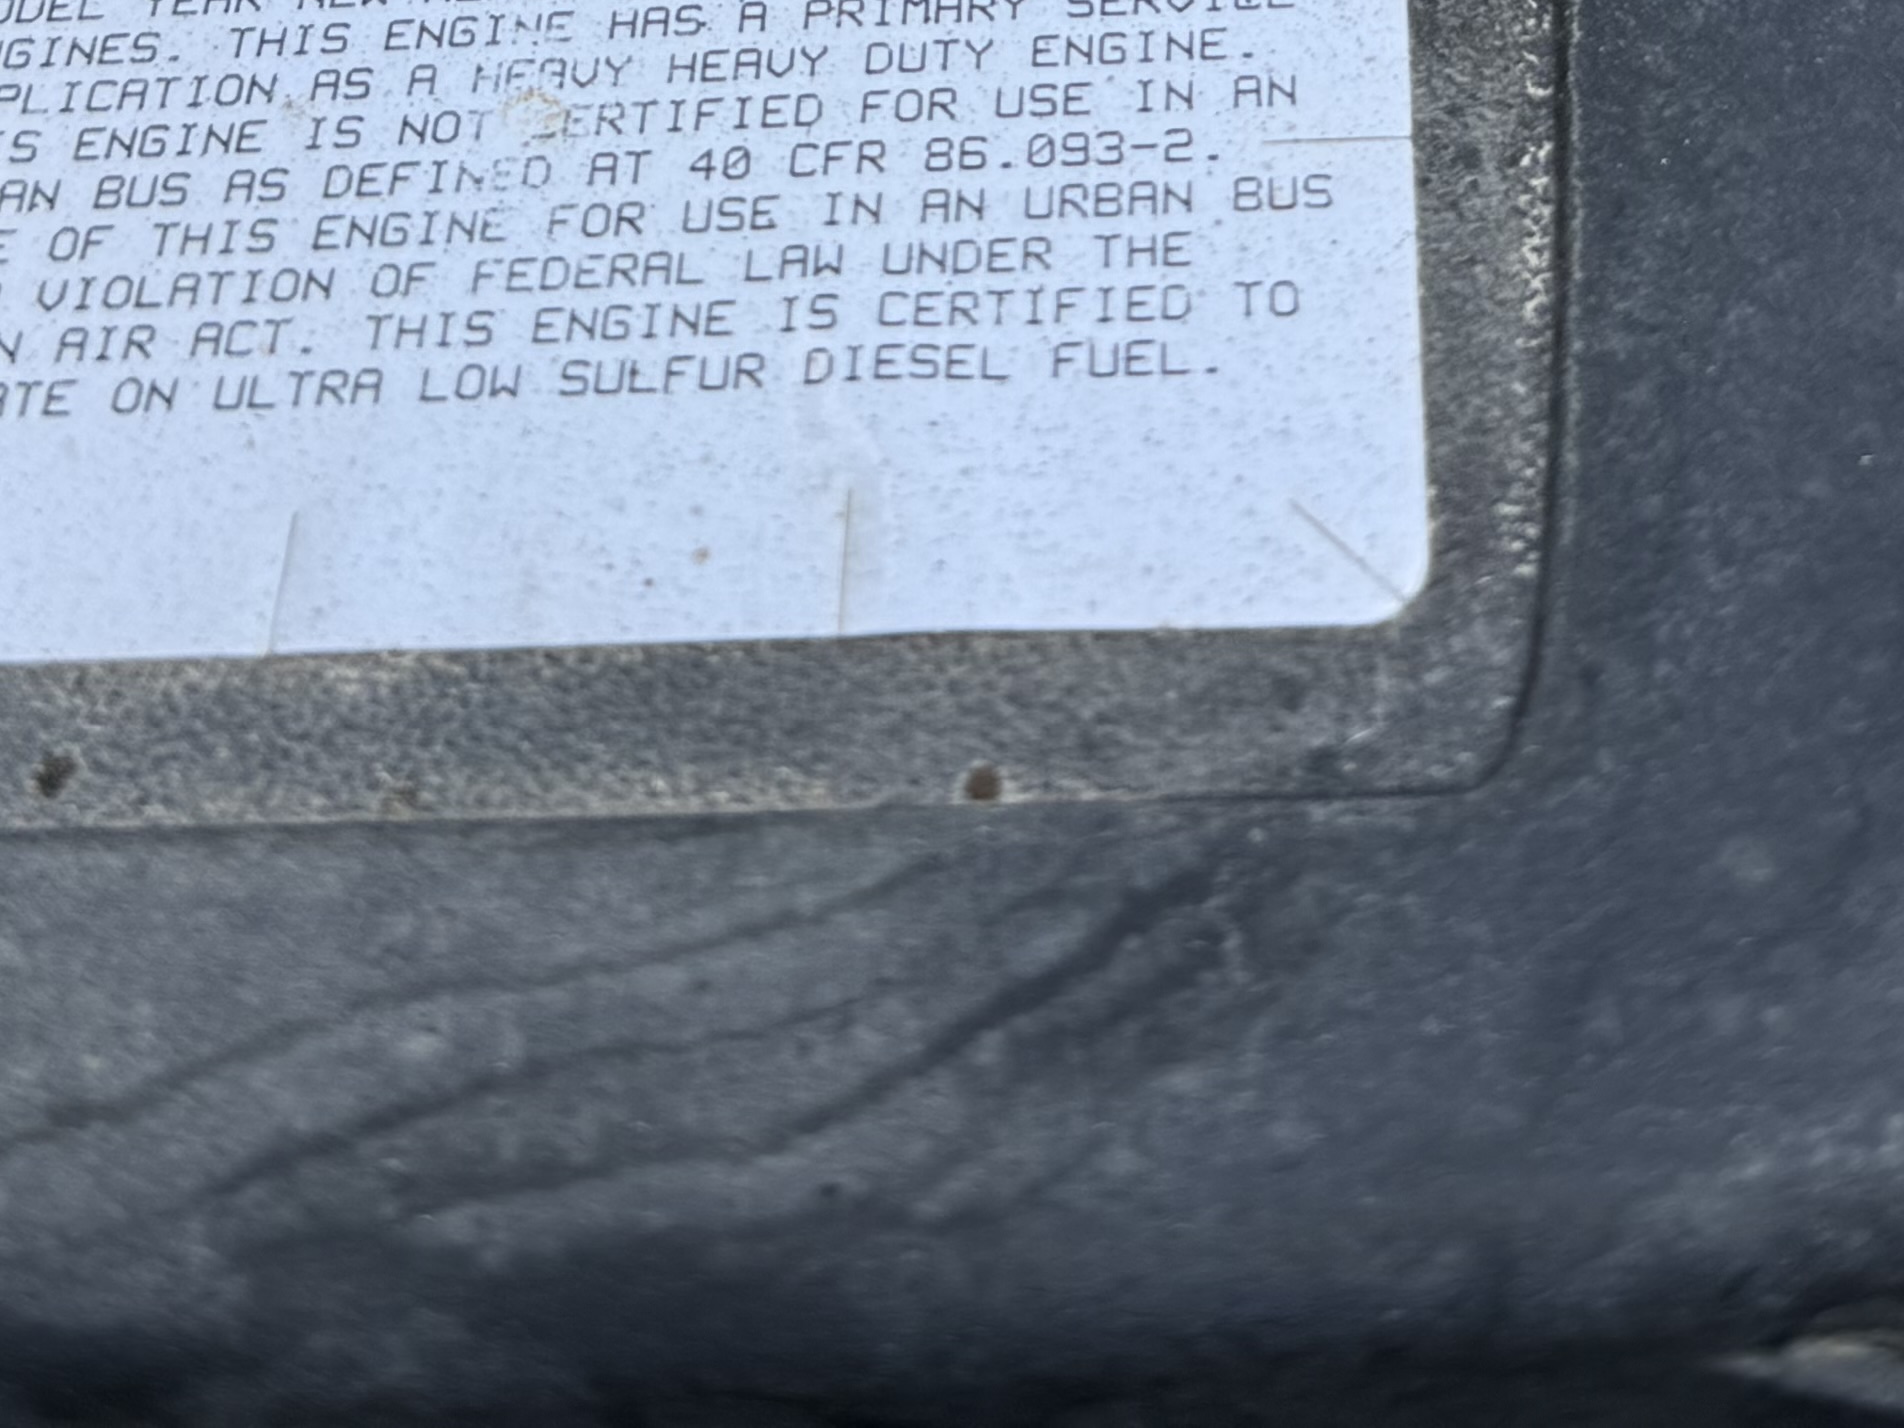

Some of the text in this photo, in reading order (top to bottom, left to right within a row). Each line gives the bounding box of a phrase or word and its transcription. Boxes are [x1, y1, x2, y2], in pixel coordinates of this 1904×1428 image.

[229, 21, 352, 60] THIS
[607, 3, 709, 41] HAS
[666, 44, 829, 85] HEAVY
[863, 37, 995, 76] DUTY
[1030, 26, 1254, 69] ENGINE.
[71, 118, 268, 163] ENGINE
[396, 109, 493, 147] NOT
[859, 86, 958, 125] FOR
[994, 81, 1094, 120] USE
[1136, 78, 1194, 114] IN
[1232, 74, 1298, 110] AN
[91, 171, 192, 211] BUS
[585, 148, 653, 187] AT
[687, 145, 753, 182] 40
[788, 138, 887, 179] CFR
[923, 127, 1220, 173] 86.093-2.
[152, 217, 280, 258] THIS
[310, 207, 508, 253] ENGINE
[546, 200, 647, 242] FOR
[680, 193, 781, 235] USE
[822, 191, 884, 228] IN
[918, 187, 988, 225] AN
[1023, 179, 1194, 221] URBAN
[1232, 173, 1334, 213] BUS
[35, 230, 1193, 314] VIOLATION FEDERAL LAW UNDER THE
[53, 323, 157, 365] AIR
[188, 317, 313, 360] ACT.
[365, 309, 497, 352] THIS
[530, 298, 737, 345] ENGINE
[876, 283, 1193, 328] CERTIFIED
[1232, 279, 1301, 320] TO
[211, 366, 384, 412] ULTRA
[417, 362, 523, 404] LOW
[557, 351, 767, 398] SULFUR
[802, 342, 1011, 387] DIESEL
[1051, 338, 1220, 380] FUEL.
